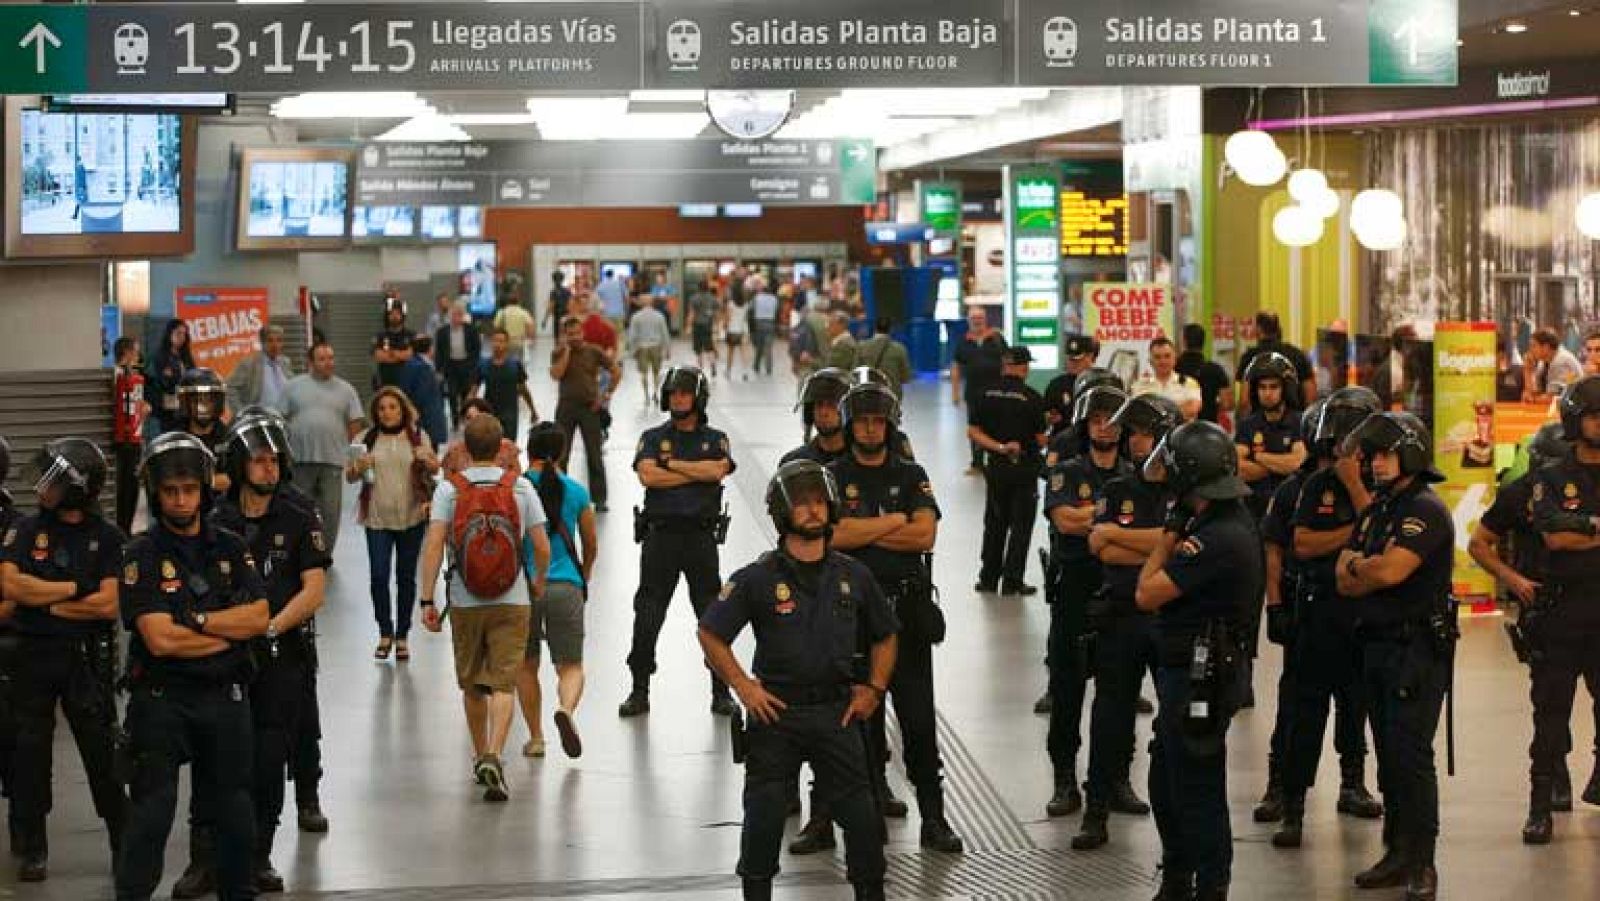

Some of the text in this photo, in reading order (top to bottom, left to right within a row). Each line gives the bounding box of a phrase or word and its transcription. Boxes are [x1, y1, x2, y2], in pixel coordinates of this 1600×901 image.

[432, 17, 617, 49] Llegadas Vías
[730, 18, 997, 48] Salidas Planta Baja
[1105, 16, 1327, 43] Salidas Planta 1
[430, 58, 593, 72] ARRIVALS PLATFORMS
[730, 55, 958, 70] DEPARTURES GROUND FLOOR
[1105, 53, 1272, 67] DEPARTURES FLOOR 1
[1092, 288, 1164, 307] COME
[1100, 308, 1159, 326] BEBE
